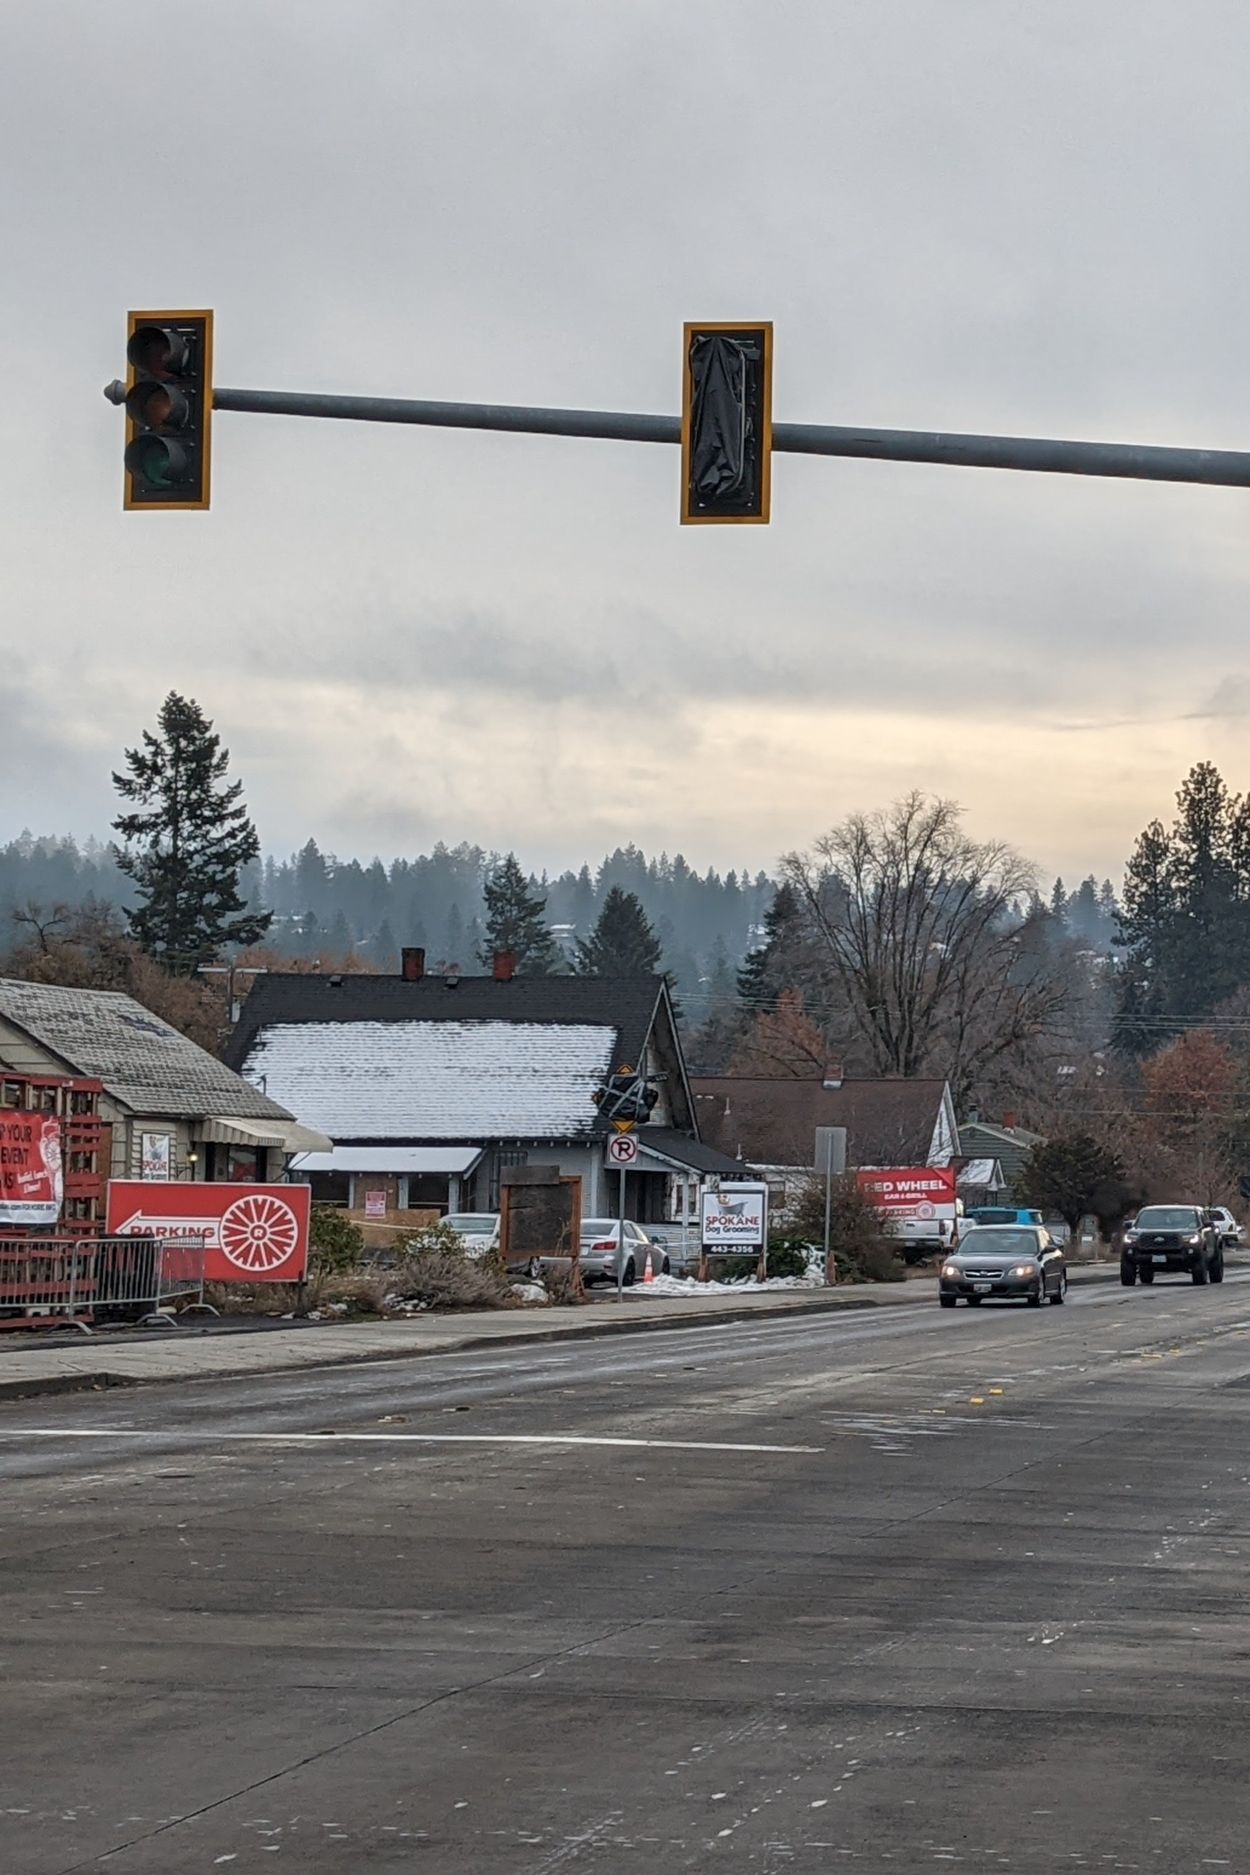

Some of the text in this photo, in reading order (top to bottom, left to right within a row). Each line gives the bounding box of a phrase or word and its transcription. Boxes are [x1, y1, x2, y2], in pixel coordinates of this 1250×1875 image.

[8, 1124, 32, 1142] YOUR
[1, 1146, 29, 1165] EVENT
[896, 1180, 947, 1192] WHEEL
[705, 1216, 760, 1226] SPOKANE
[130, 1225, 215, 1239] PARKING
[254, 1228, 265, 1237] R
[705, 1225, 760, 1234] Dog Grooming
